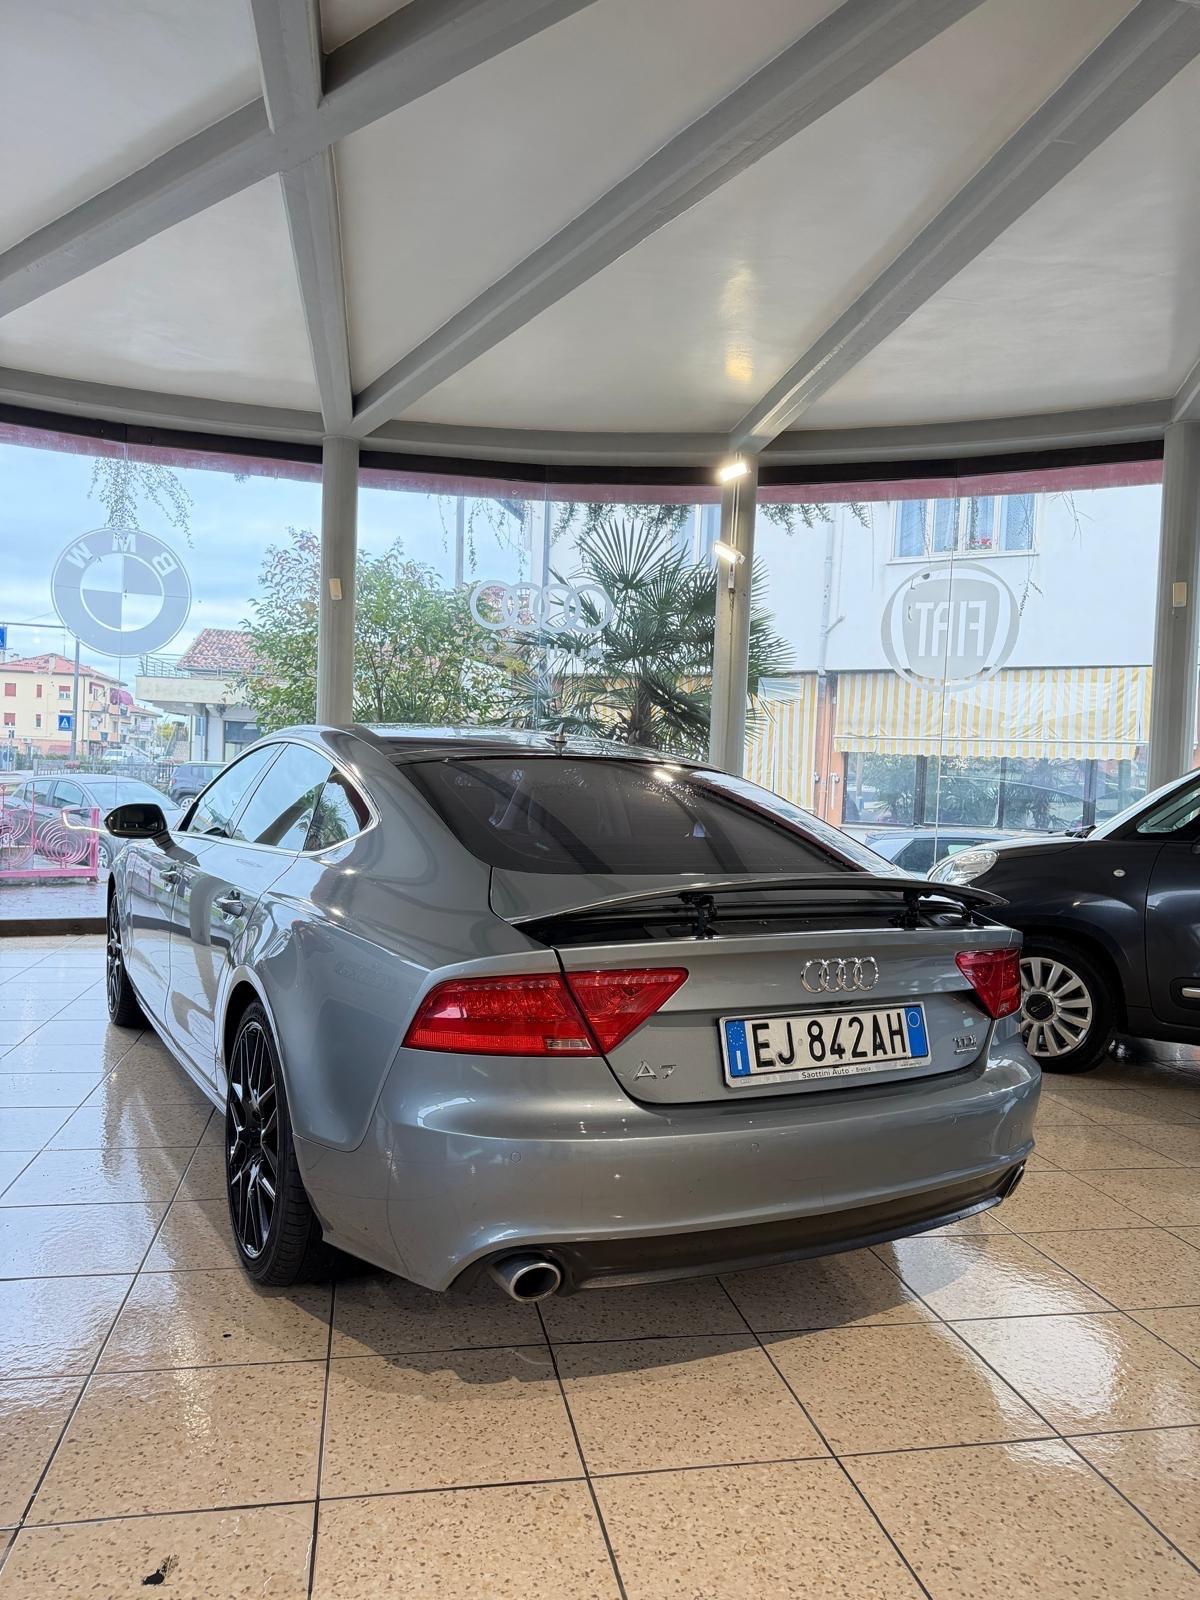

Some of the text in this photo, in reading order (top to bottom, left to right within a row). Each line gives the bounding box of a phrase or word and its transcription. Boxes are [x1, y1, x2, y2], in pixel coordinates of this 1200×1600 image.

[752, 1012, 907, 1068] EJ 842AH
[633, 1059, 677, 1081] A7
[736, 1050, 743, 1070] I
[801, 1068, 831, 1079] Saottini
[832, 1066, 850, 1076] Auto
